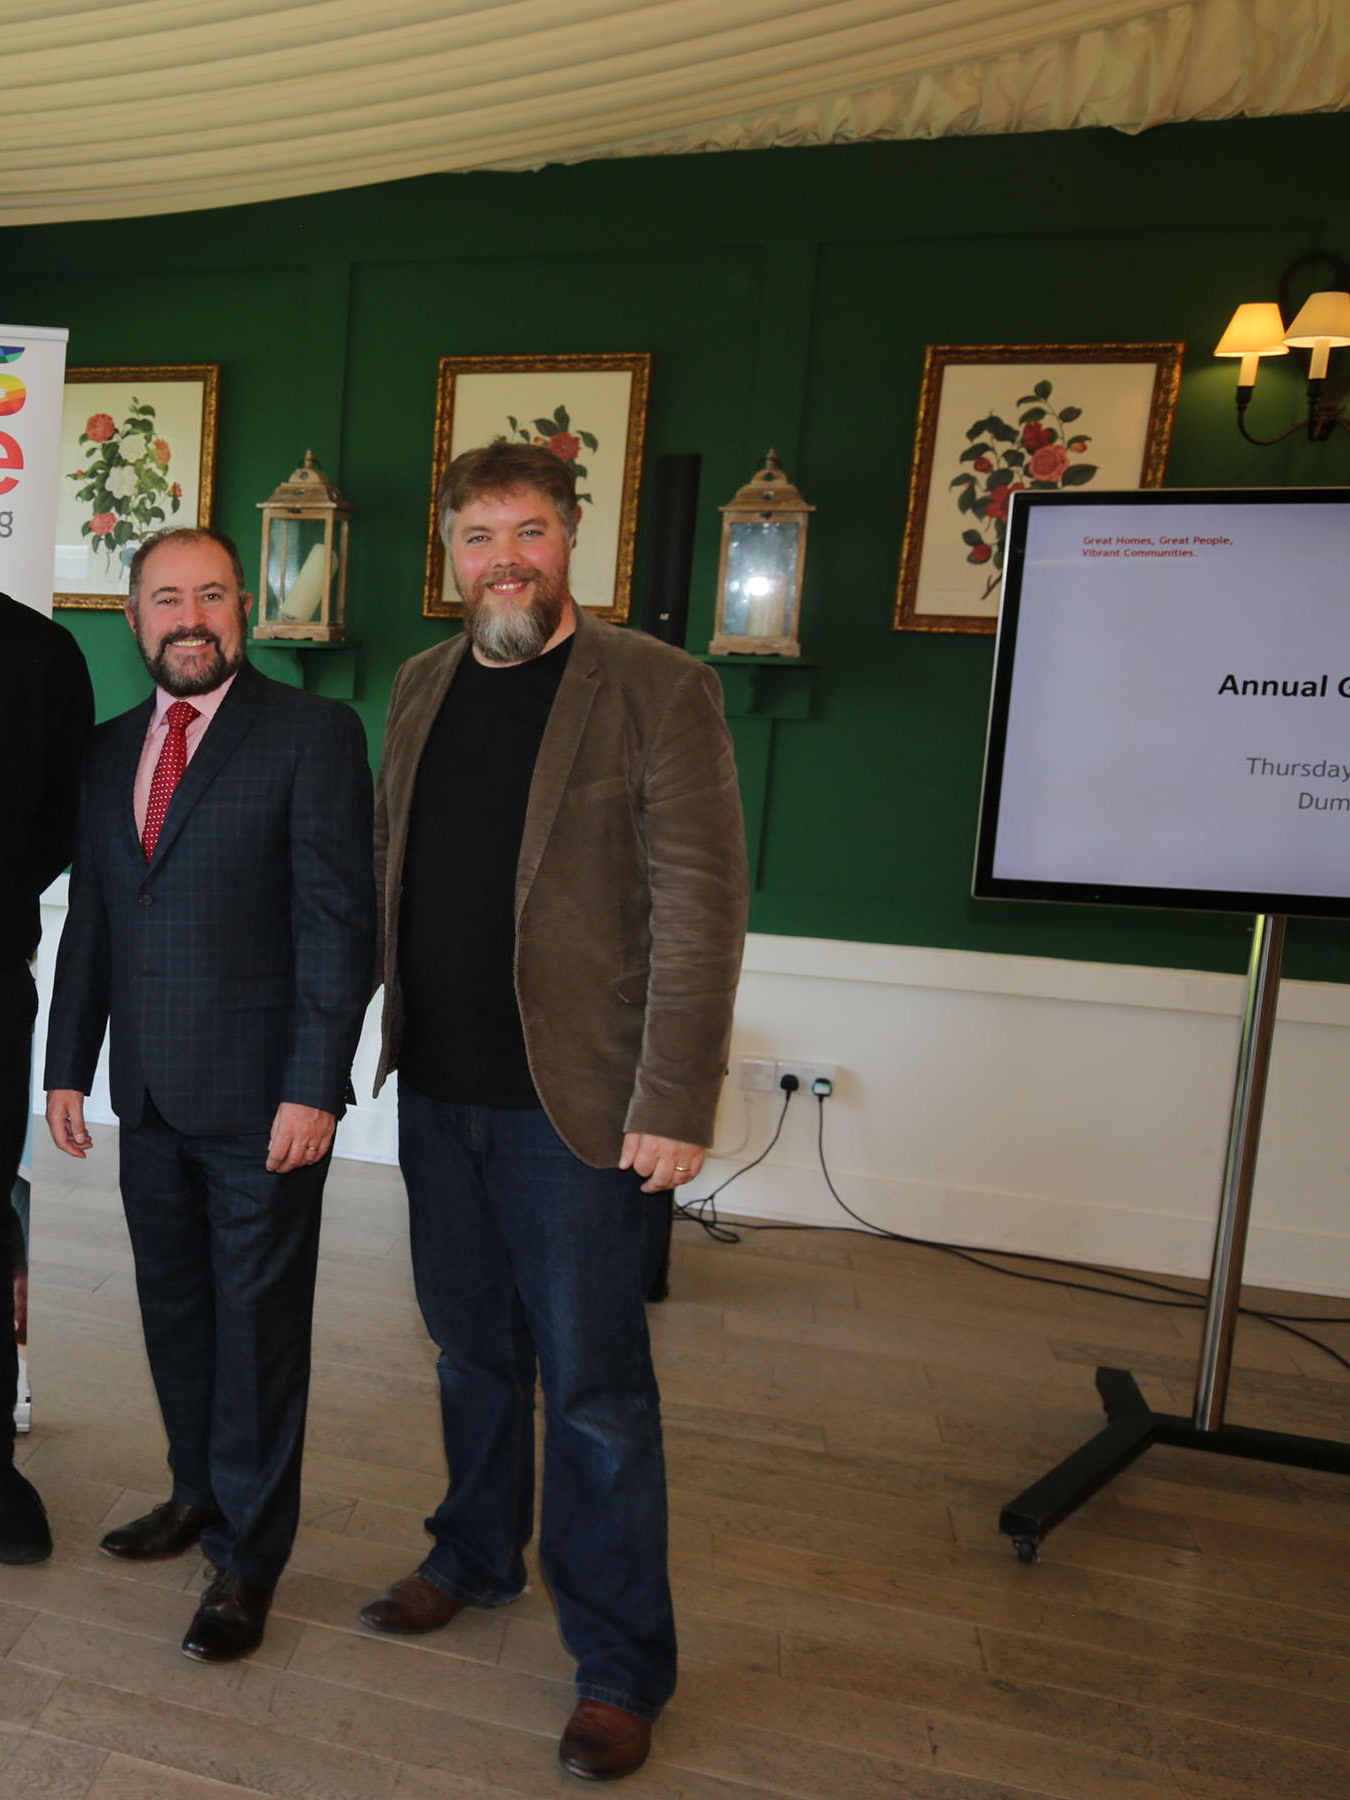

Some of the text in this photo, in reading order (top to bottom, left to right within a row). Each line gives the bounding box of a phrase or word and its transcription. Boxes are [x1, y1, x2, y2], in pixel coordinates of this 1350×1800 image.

[1083, 536, 1233, 547] Great Homes, Great People,
[1082, 548, 1197, 557] Vibrant Communities.
[1217, 674, 1329, 698] Annual
[1245, 757, 1350, 783] Thursday
